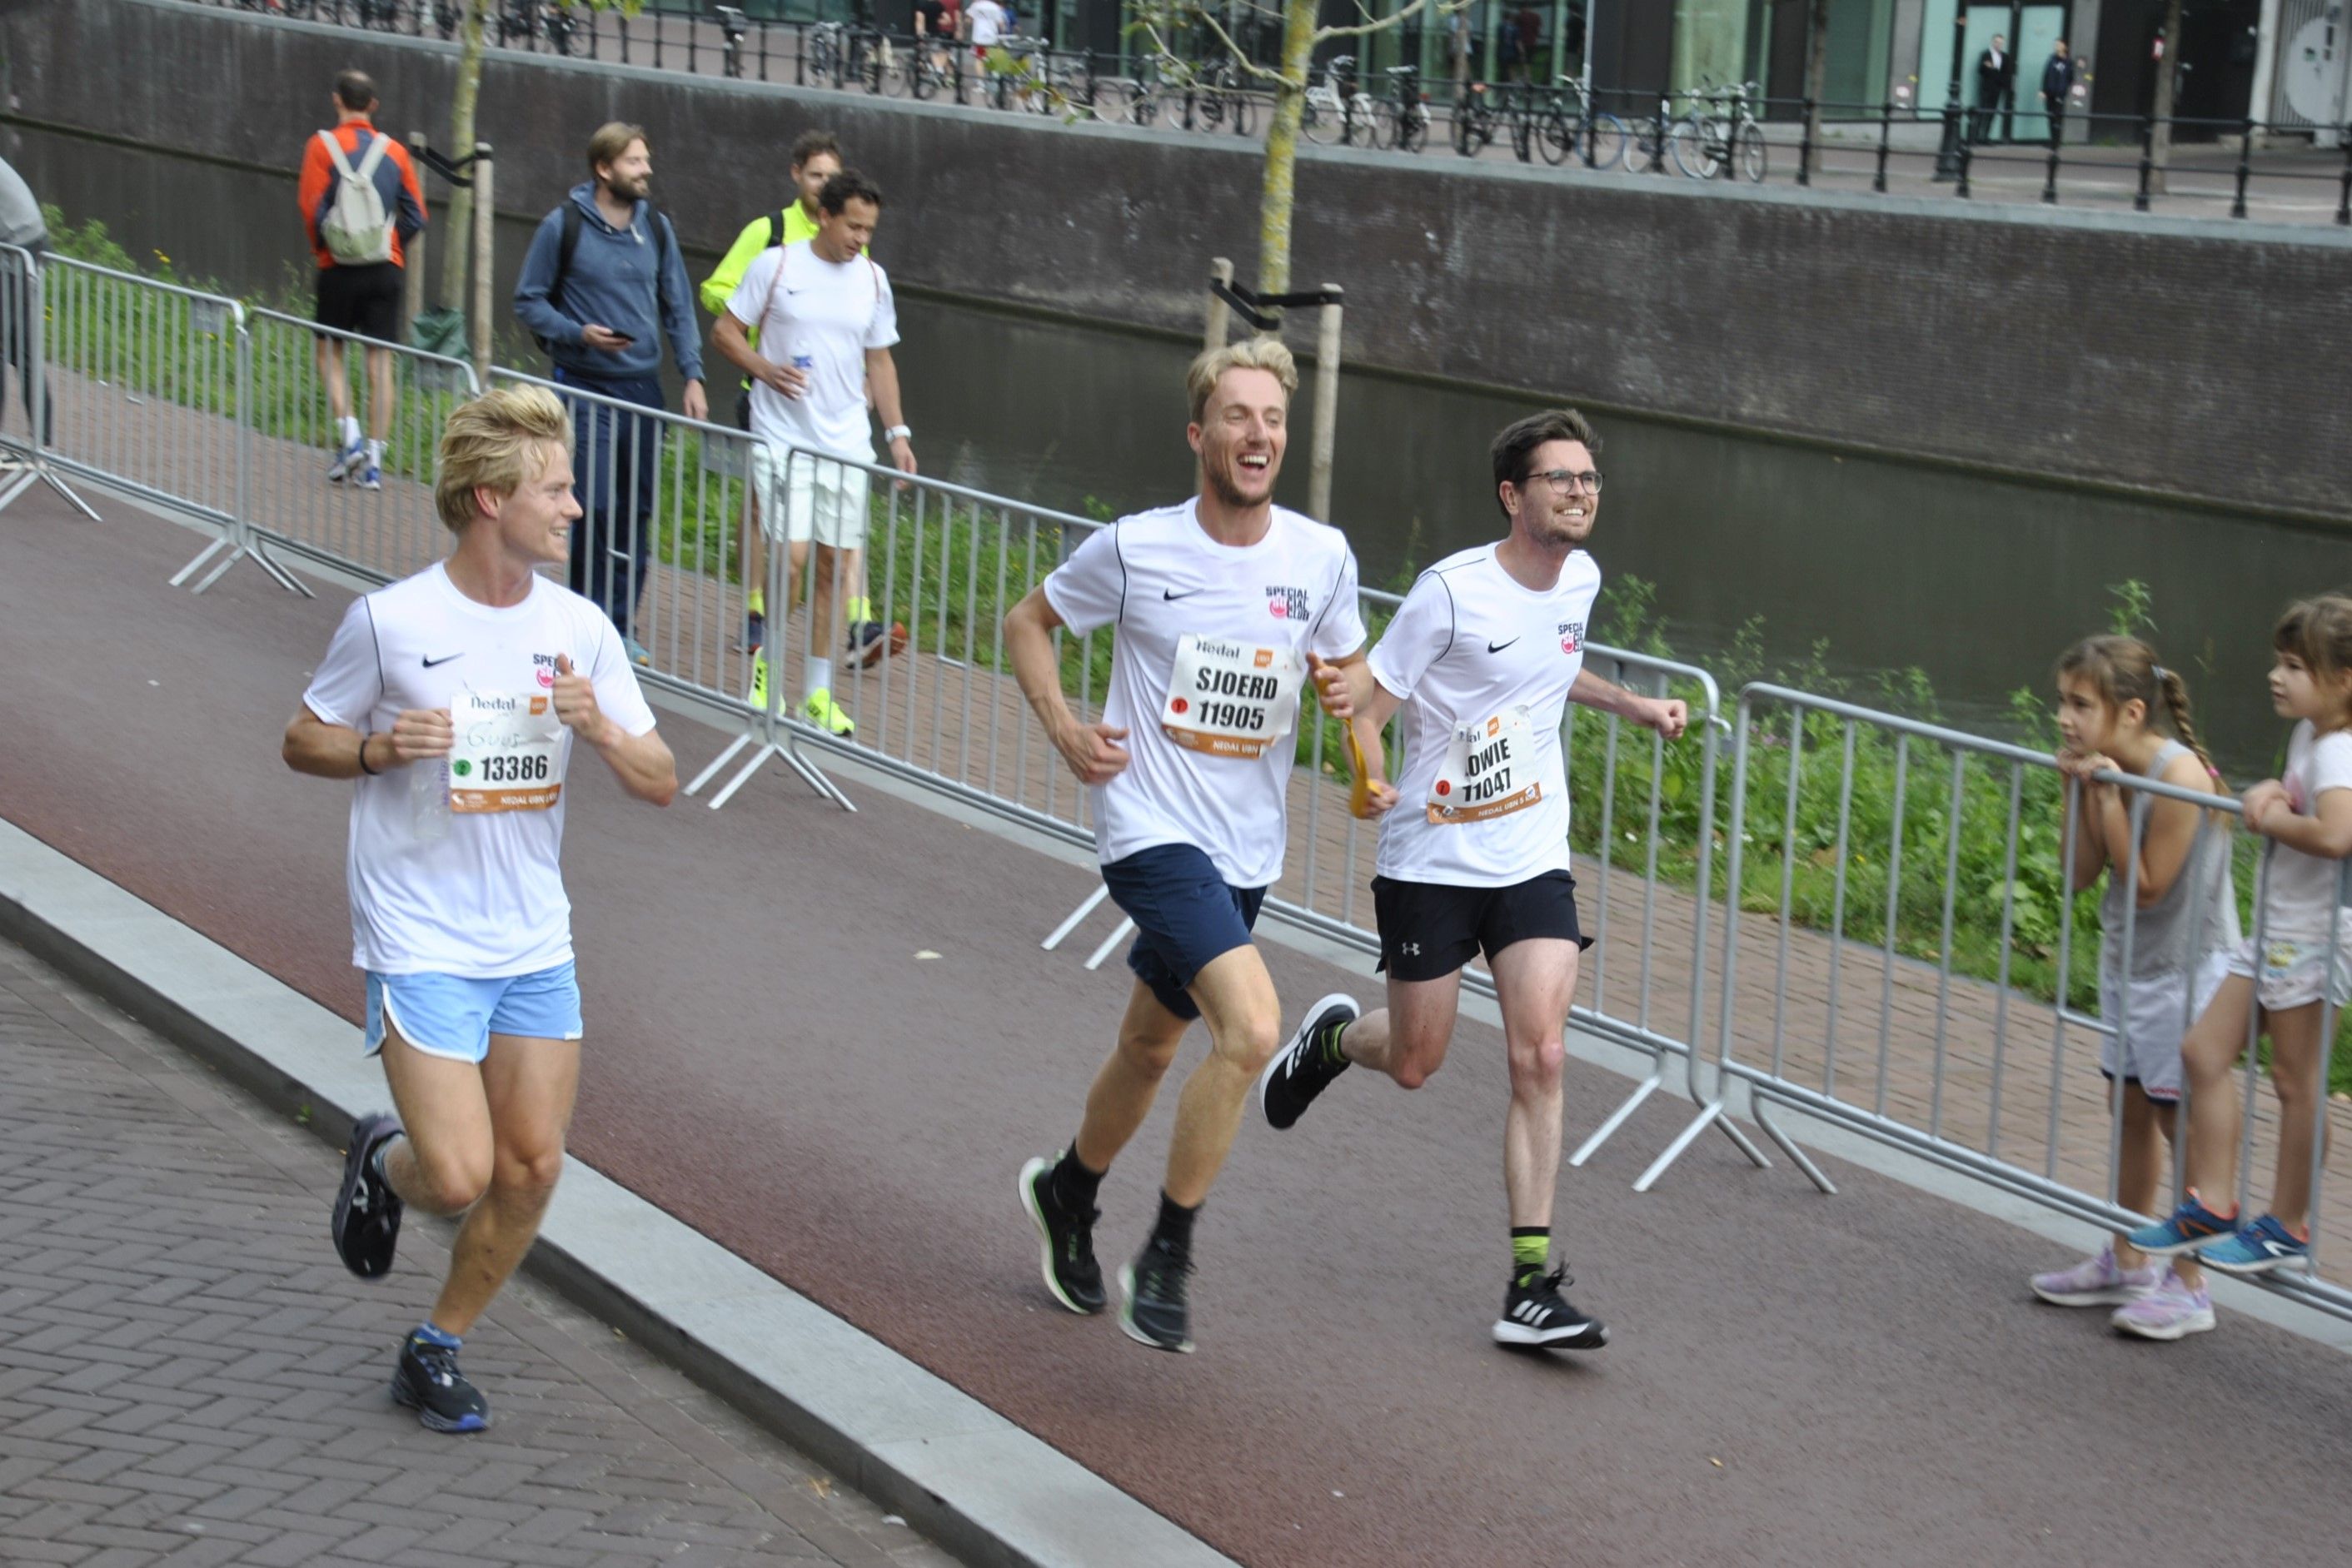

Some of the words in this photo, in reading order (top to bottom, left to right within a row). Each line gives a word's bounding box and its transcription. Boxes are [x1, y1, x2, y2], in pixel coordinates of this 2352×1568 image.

[1196, 667, 1278, 700] SJOERD
[1199, 701, 1265, 731] 11905
[481, 754, 548, 781] 13386
[1464, 738, 1511, 778] OWIE
[1462, 766, 1512, 802] 11047
[1477, 805, 1502, 817] NEDAL
